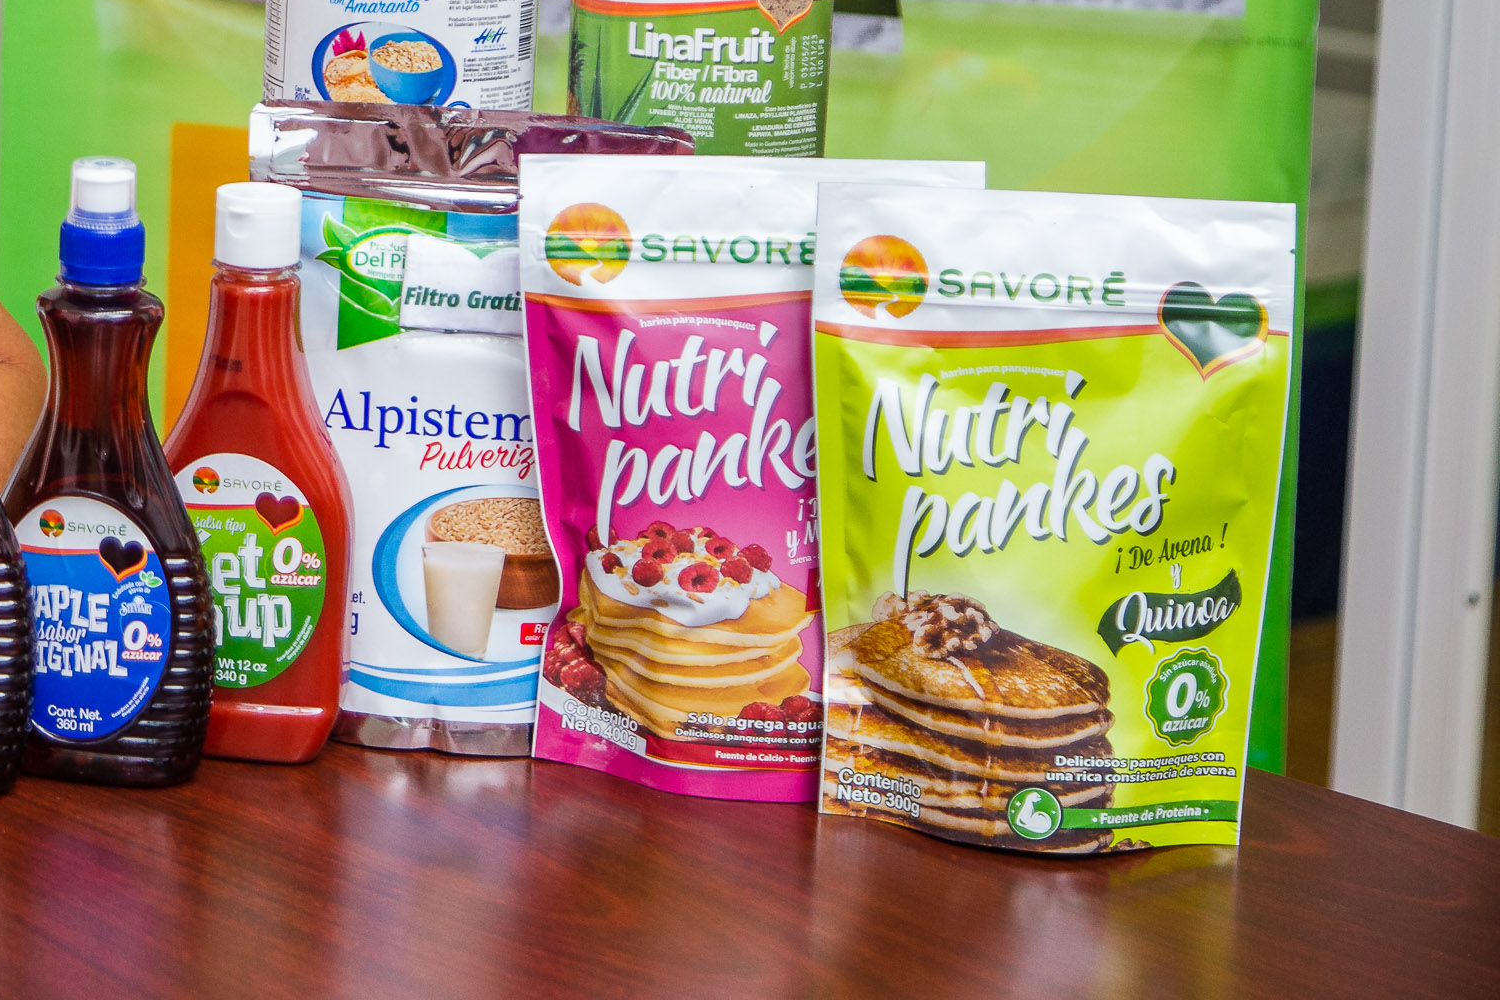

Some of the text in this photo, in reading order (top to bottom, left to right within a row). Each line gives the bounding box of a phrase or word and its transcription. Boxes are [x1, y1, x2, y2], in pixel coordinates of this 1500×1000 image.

[473, 26, 508, 45] H&H
[629, 21, 775, 65] LinaFruit
[800, 35, 810, 78] 03/05/22
[809, 34, 818, 77] 03/11/23
[655, 60, 758, 83] Fiber / Fibra
[650, 79, 773, 105] 100% natural
[683, 104, 706, 112] benefits
[674, 117, 715, 126] ALOE VERA,
[752, 123, 783, 132] LEVADURA
[688, 130, 714, 138] APPLE
[370, 241, 407, 253] Produc
[355, 251, 385, 267] Del
[404, 285, 460, 308] Filtro
[639, 315, 757, 331] harina para panqueques
[568, 321, 780, 433] Nutri
[940, 364, 1065, 380] harina para panqueques
[863, 369, 1088, 482] Nutri
[596, 377, 818, 548] panke
[193, 514, 247, 535] salsa tipo
[892, 427, 1177, 599] pankes
[272, 536, 321, 575] 0%
[786, 530, 800, 558] y
[211, 533, 267, 596] et
[789, 555, 812, 566] avena
[270, 572, 322, 587] azúcar
[1169, 562, 1182, 589] y
[31, 583, 111, 633] APLE
[38, 619, 87, 644] sabor
[214, 593, 292, 648] up
[1115, 591, 1239, 655] Quinoa
[123, 619, 162, 651] 0%
[34, 639, 128, 678] IGINAL
[121, 649, 163, 661] azúcar
[218, 657, 268, 673] Wt 12 oz
[215, 669, 247, 685] 340 g
[1159, 668, 1173, 683] Sin
[1172, 658, 1200, 673] azúcar
[1166, 671, 1211, 719] 0%
[47, 703, 103, 721] Cont. Net.
[562, 698, 638, 733] Contenido
[687, 711, 824, 733] Sólo agrega agua
[56, 718, 94, 733] 360 ml
[561, 714, 638, 751] Neto 400g
[1161, 715, 1210, 733] azúcar
[675, 727, 807, 746] Deliciosos panqueques con
[715, 751, 818, 764] Fuente de Calcio Fuente
[1054, 751, 1225, 770] Deliciosos panqueques con
[837, 767, 922, 799] Contenido
[1045, 764, 1237, 784] una rica consistencia de avena
[837, 784, 921, 819] Neto 300g
[1100, 804, 1202, 826] Fuente de Proteína
